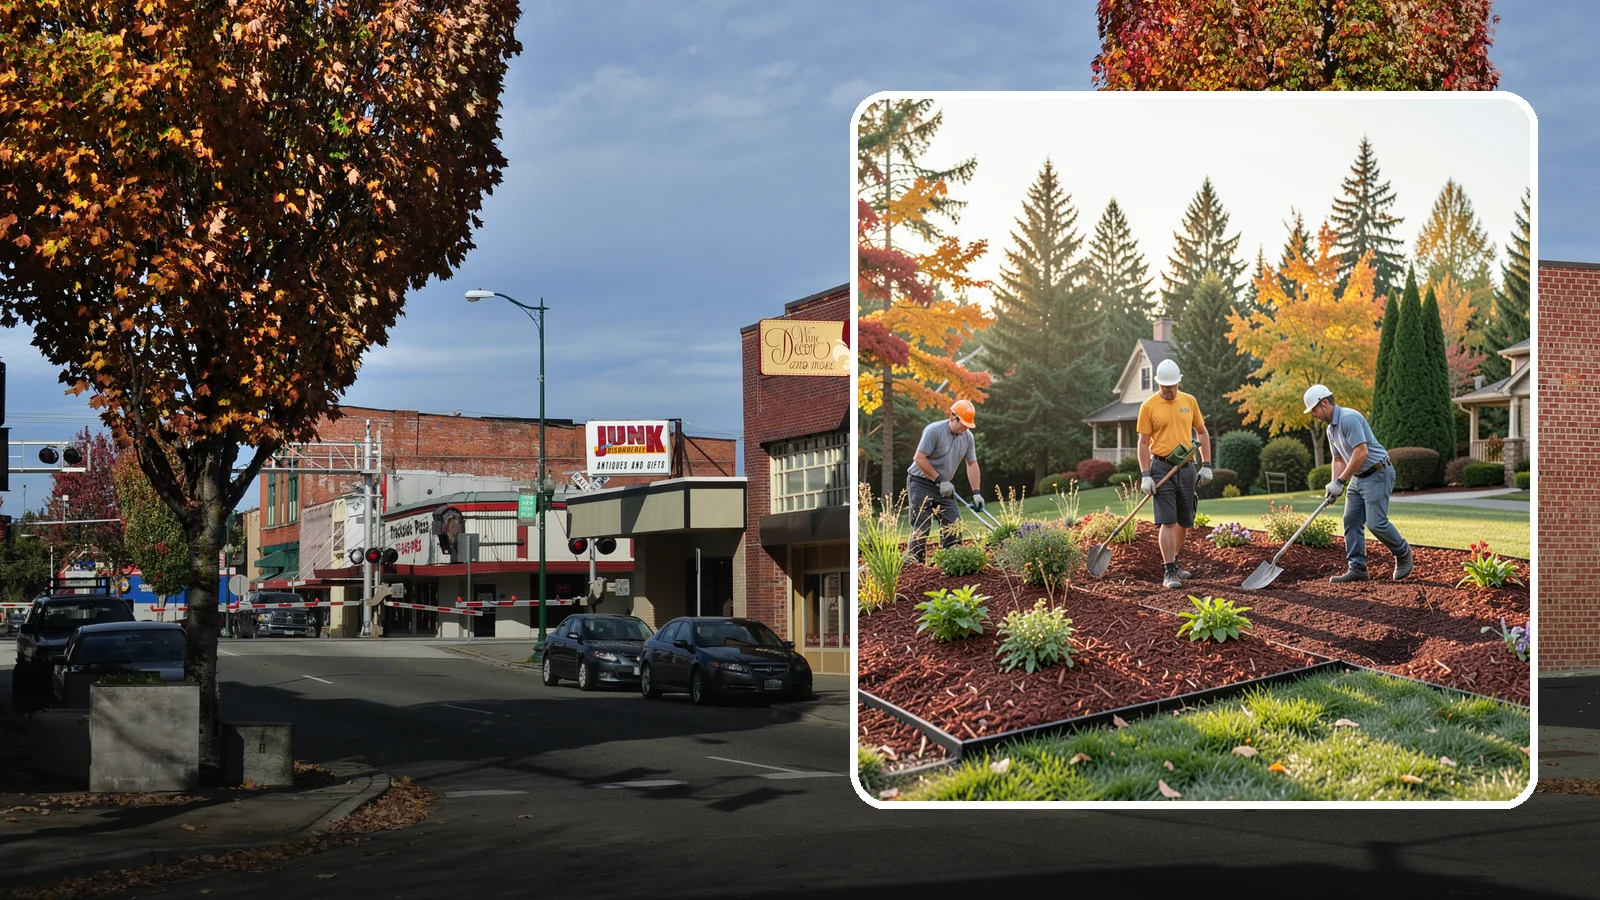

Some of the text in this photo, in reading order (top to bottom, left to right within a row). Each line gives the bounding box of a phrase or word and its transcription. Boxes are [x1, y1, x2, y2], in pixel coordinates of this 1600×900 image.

[596, 425, 664, 457] JUNK
[607, 446, 646, 454] DISORDERLY
[597, 460, 665, 470] ANTIQUES AND GIFTS
[390, 519, 429, 540] Trackside Pizza
